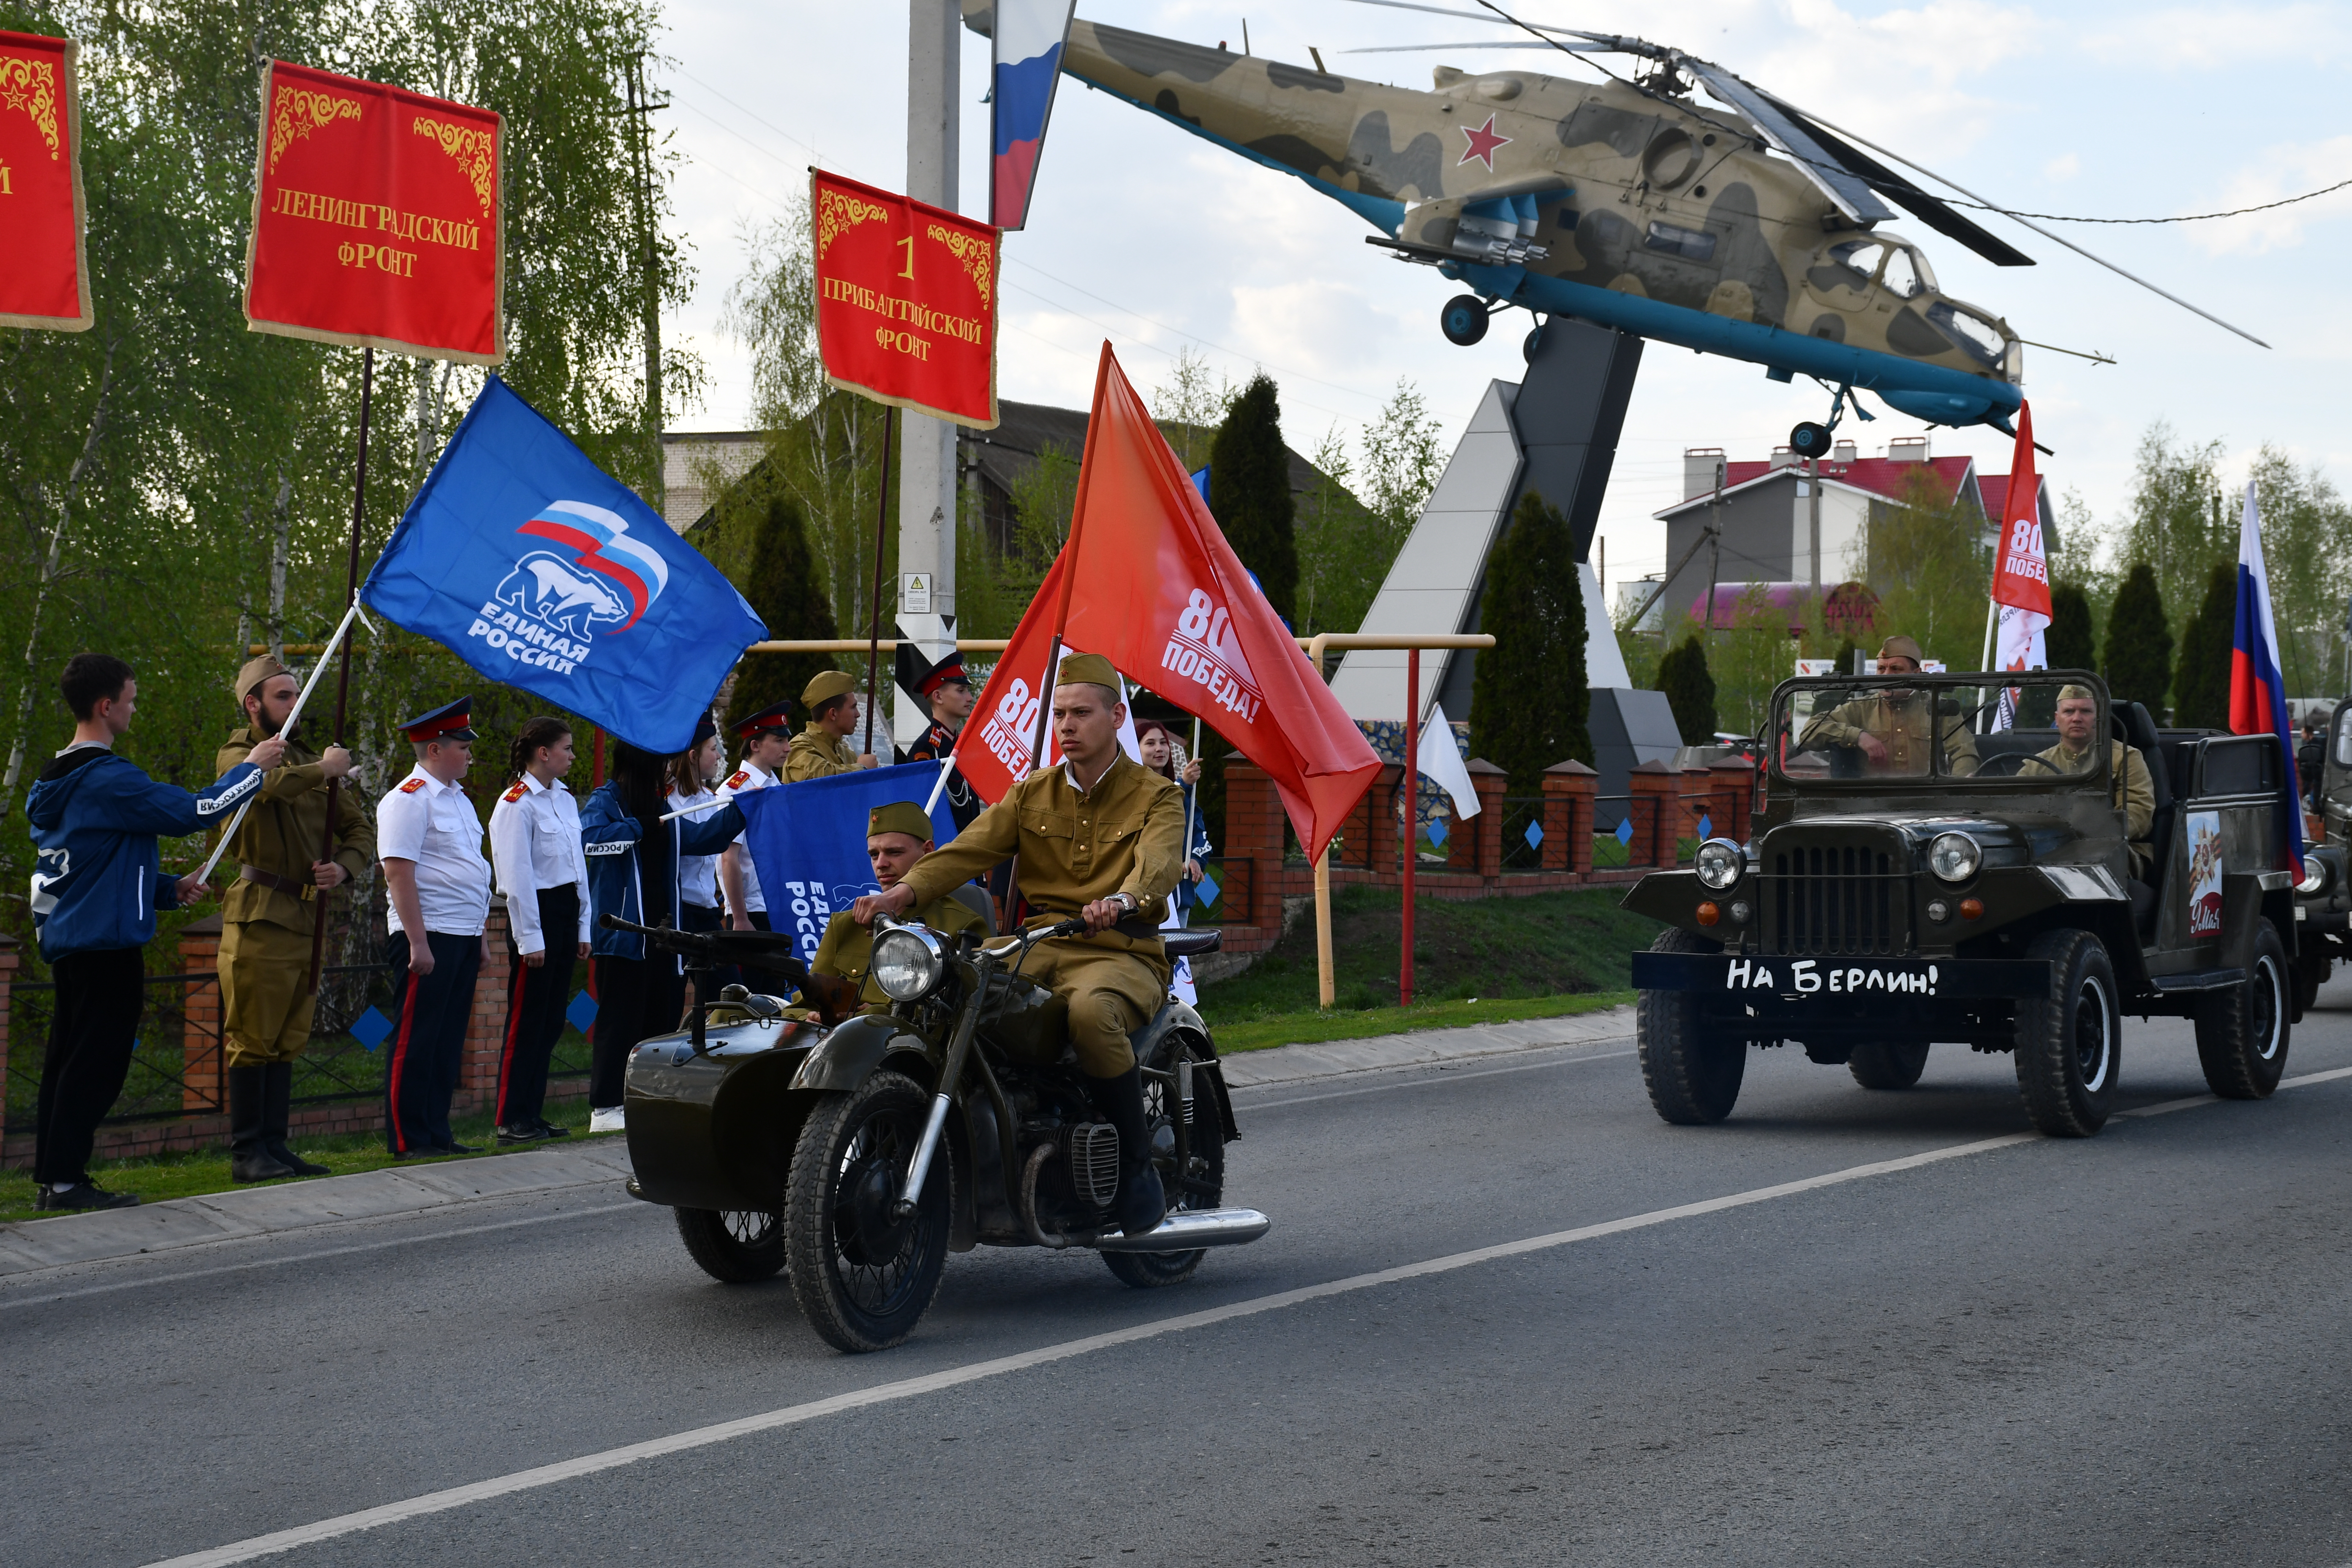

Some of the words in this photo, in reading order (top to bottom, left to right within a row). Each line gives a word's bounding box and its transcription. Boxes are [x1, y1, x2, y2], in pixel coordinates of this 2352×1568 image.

[271, 188, 480, 251] ЛЕНИНГРАДСКИЙ
[338, 241, 417, 278] ФРОНТ
[896, 235, 915, 281] 1
[823, 277, 983, 345] ПРИБАЛТИЙСКИЙ
[875, 326, 931, 361] ФРОНТ
[2010, 519, 2042, 554] 80
[2005, 556, 2049, 587] ПОБЕД
[467, 618, 578, 675] РОССИЯ
[480, 601, 591, 663] ЕДИНАЯ
[1178, 588, 1232, 651] 80
[999, 678, 1039, 736] 80
[1161, 640, 1261, 724] ПОБЕДА!
[980, 718, 1031, 782] ПОБЕД
[587, 844, 621, 853] РОССИЯ
[809, 881, 830, 934] ЕДИ
